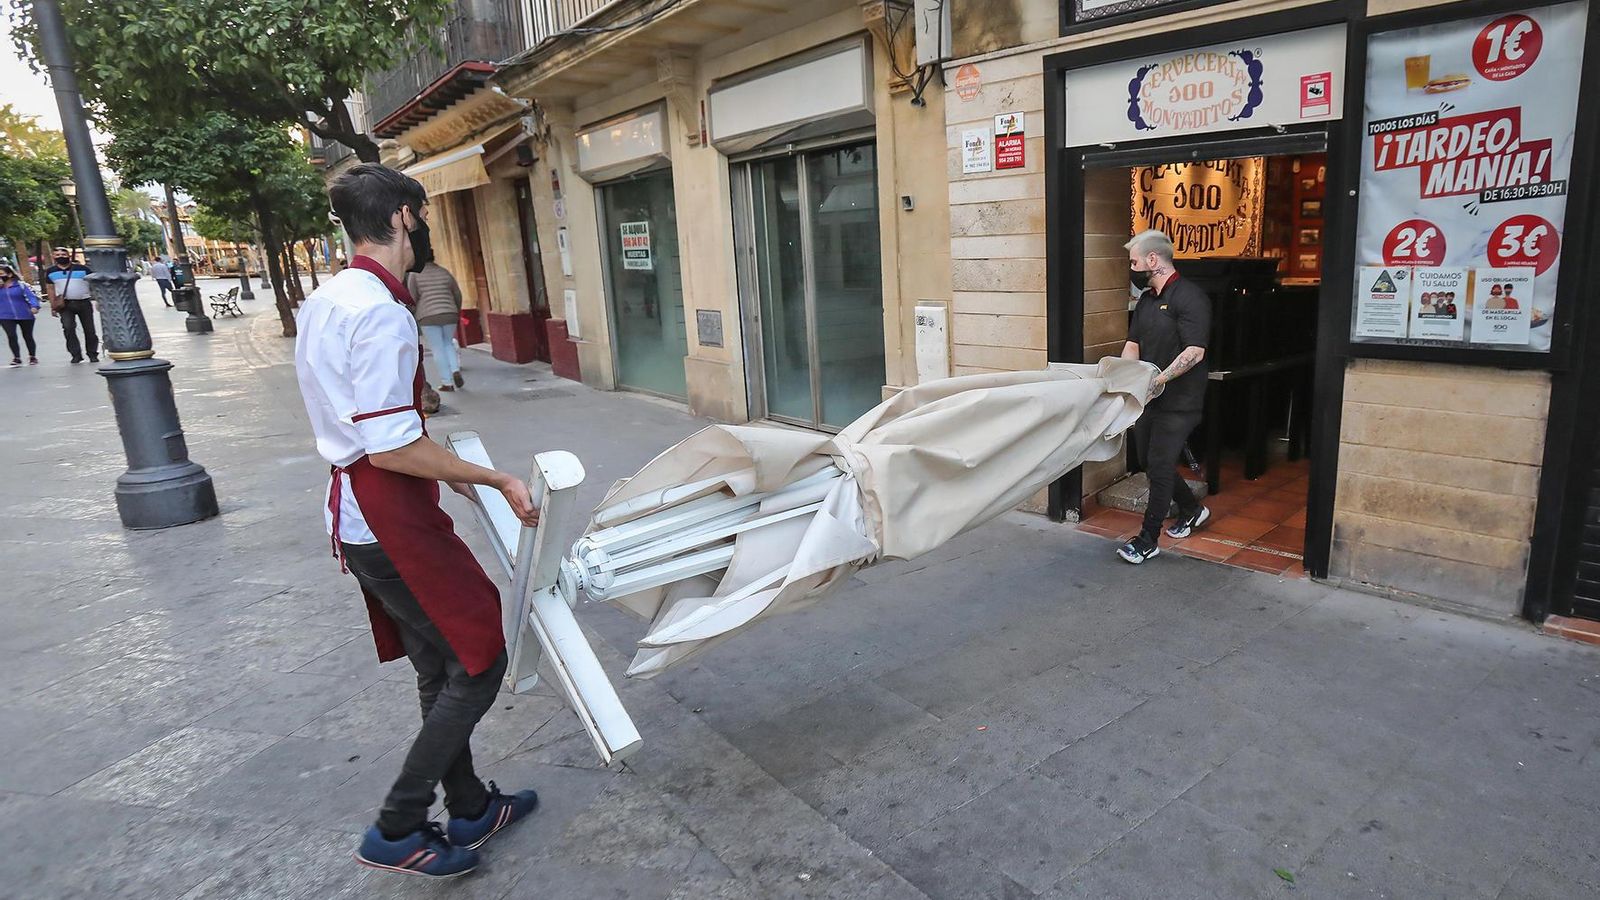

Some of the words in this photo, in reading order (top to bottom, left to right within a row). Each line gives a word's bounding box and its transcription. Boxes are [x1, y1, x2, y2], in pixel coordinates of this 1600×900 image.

[1486, 20, 1533, 64] 1€
[1142, 88, 1243, 130] MONTADITOS
[1369, 120, 1397, 134] TODOS
[1397, 117, 1414, 129] LOS
[1415, 112, 1437, 127] DÍAS
[998, 139, 1022, 148] ALARMA
[1483, 189, 1498, 201] DE
[1500, 182, 1563, 200] 16:30-19:30H
[622, 225, 628, 235] SE
[628, 224, 647, 235] ALQUILA
[1140, 195, 1247, 253] MONTADITOS
[1392, 227, 1437, 257] 2€
[1497, 225, 1548, 257] 3€
